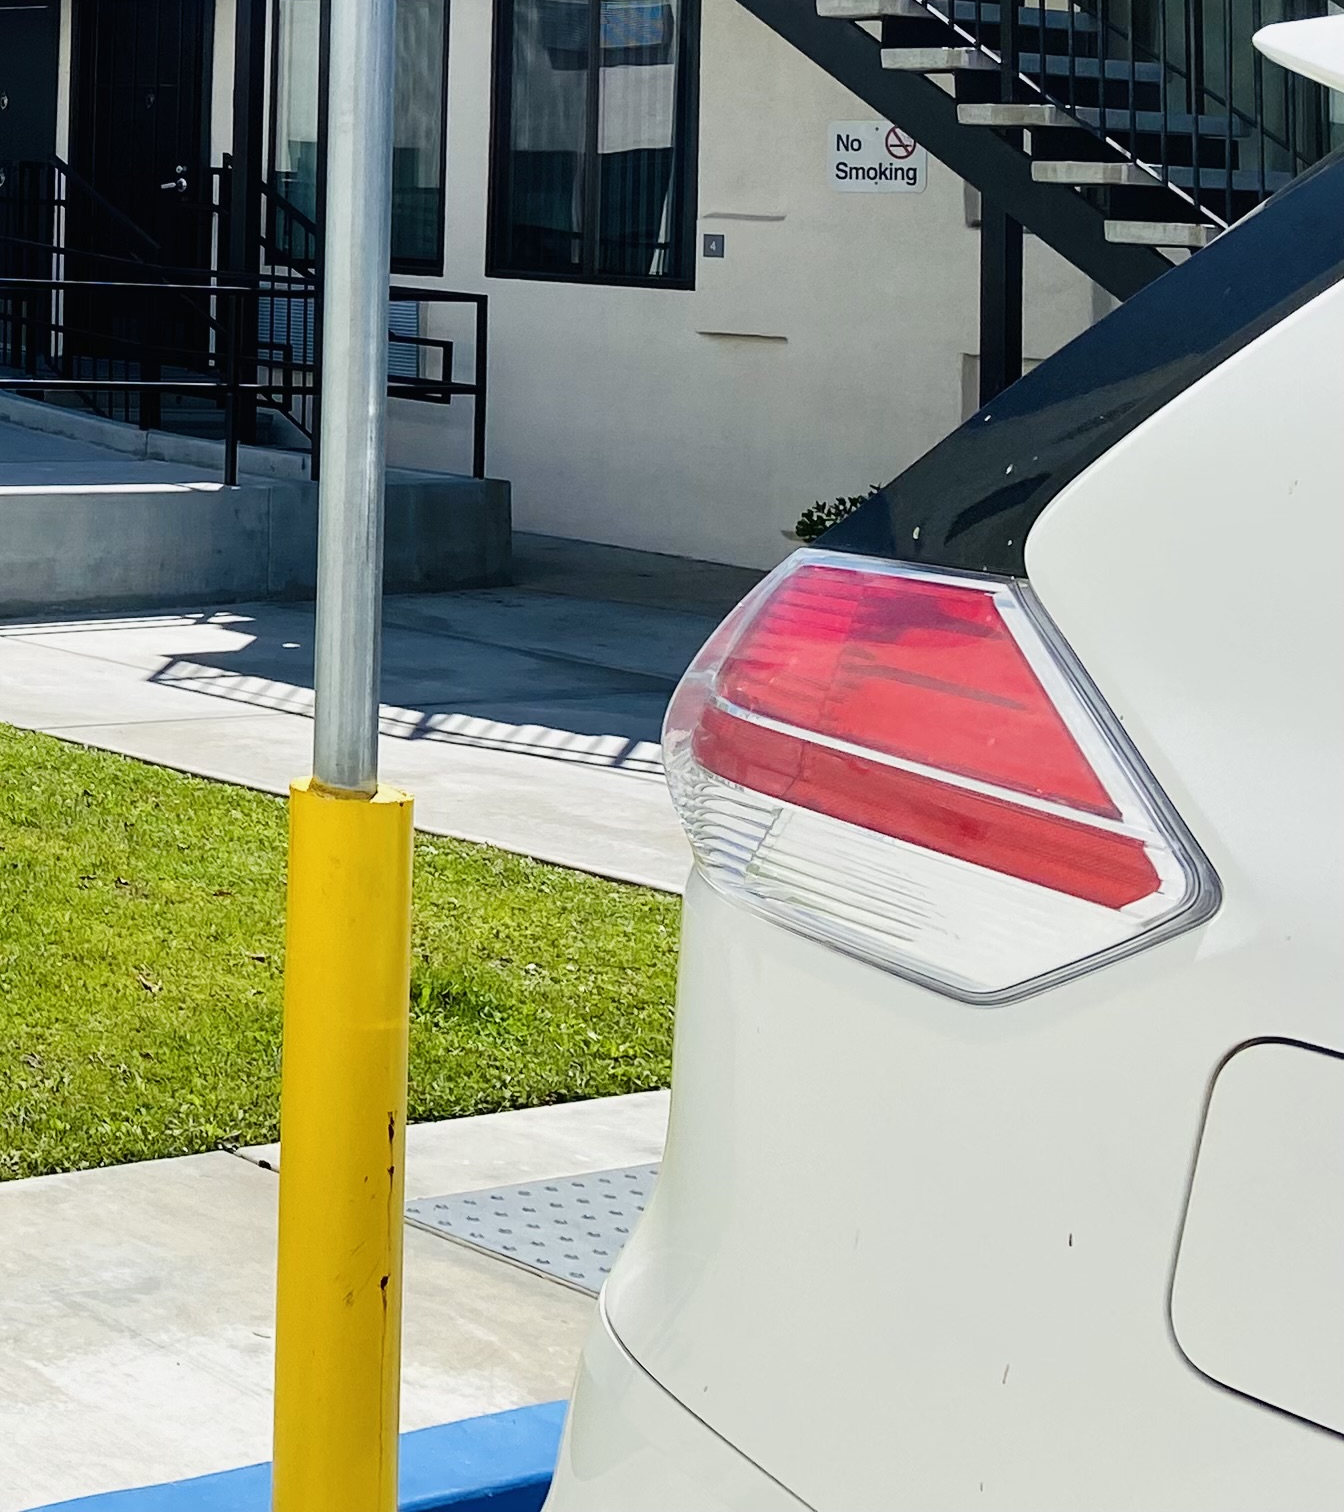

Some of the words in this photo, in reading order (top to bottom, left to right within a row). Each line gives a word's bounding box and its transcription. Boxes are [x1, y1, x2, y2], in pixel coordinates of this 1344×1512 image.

[836, 133, 862, 152] No
[835, 161, 918, 186] Smoking
[709, 240, 716, 251] 4
